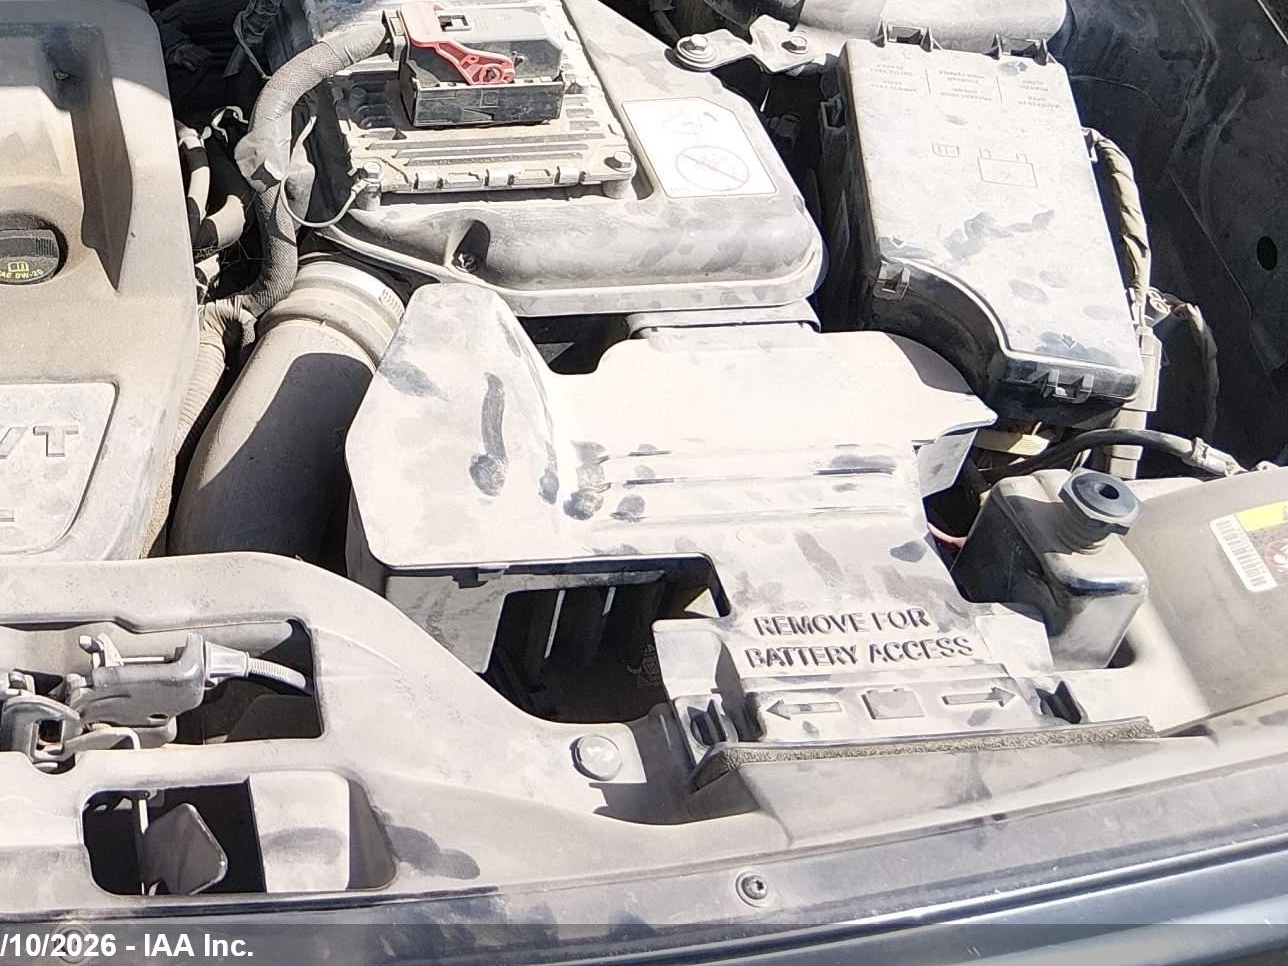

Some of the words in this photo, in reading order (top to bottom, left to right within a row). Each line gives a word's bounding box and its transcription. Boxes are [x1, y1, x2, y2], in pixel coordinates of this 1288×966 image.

[753, 611, 866, 636] REMOVE
[871, 607, 931, 632] FOR
[745, 645, 858, 669] BATTERY
[868, 636, 975, 664] ACCESS
